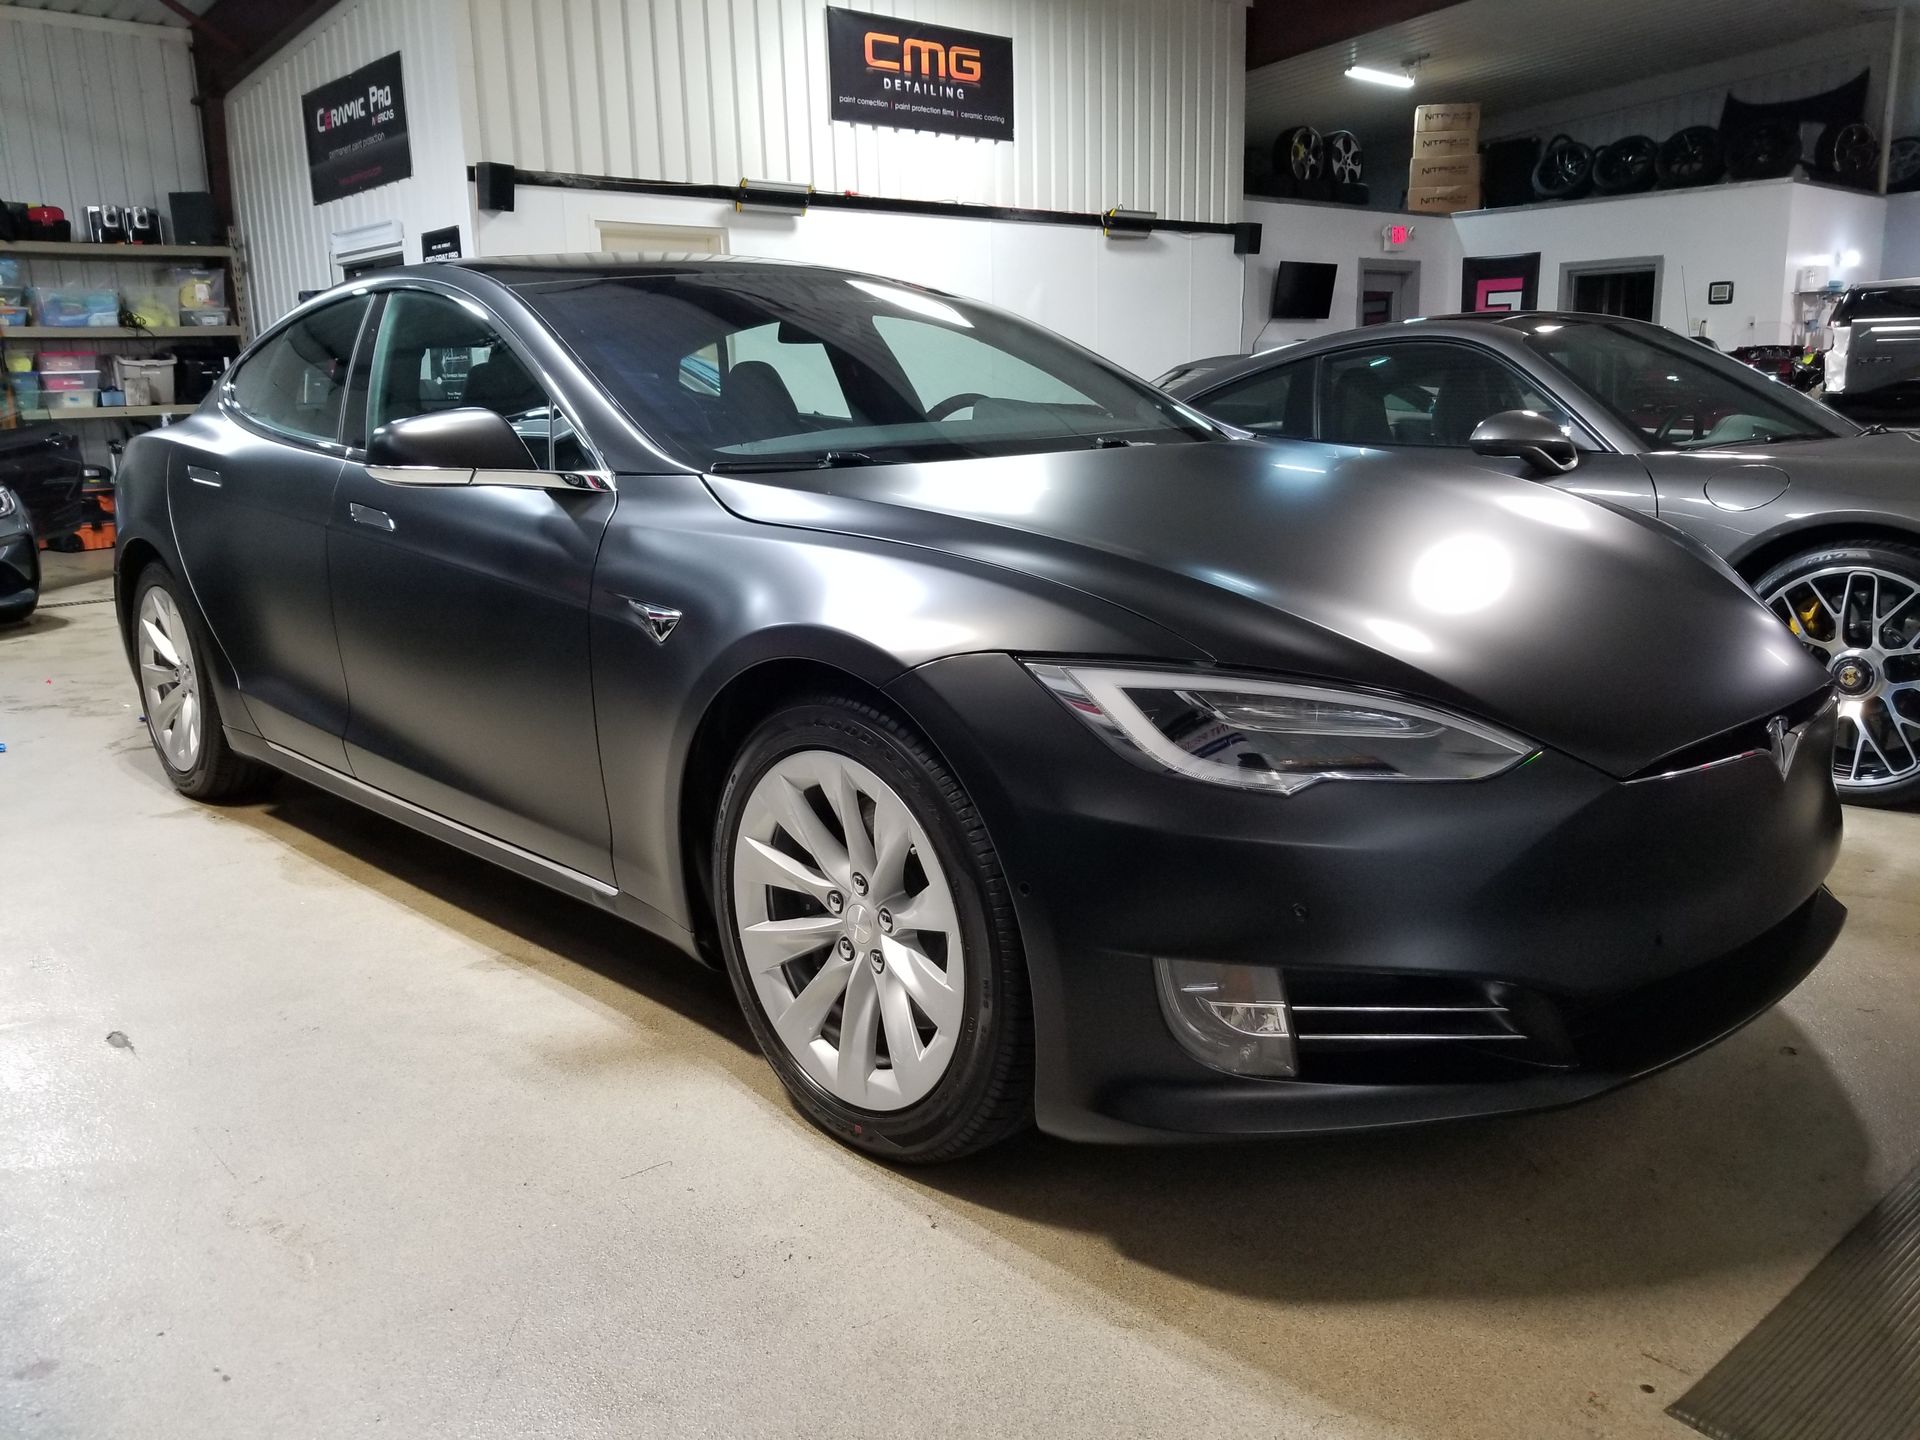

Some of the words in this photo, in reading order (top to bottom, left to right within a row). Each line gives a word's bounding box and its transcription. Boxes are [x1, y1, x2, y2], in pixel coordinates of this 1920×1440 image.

[863, 31, 981, 82] CMG
[883, 77, 965, 100] DETAILING
[317, 97, 365, 132] CERAMIC
[368, 85, 392, 113] PRO
[839, 95, 856, 104] paint
[856, 98, 889, 108] correction
[894, 102, 911, 111] paint
[911, 104, 941, 115] protection
[941, 108, 955, 117] films
[960, 111, 983, 121] ceramic
[983, 114, 1005, 125] coating
